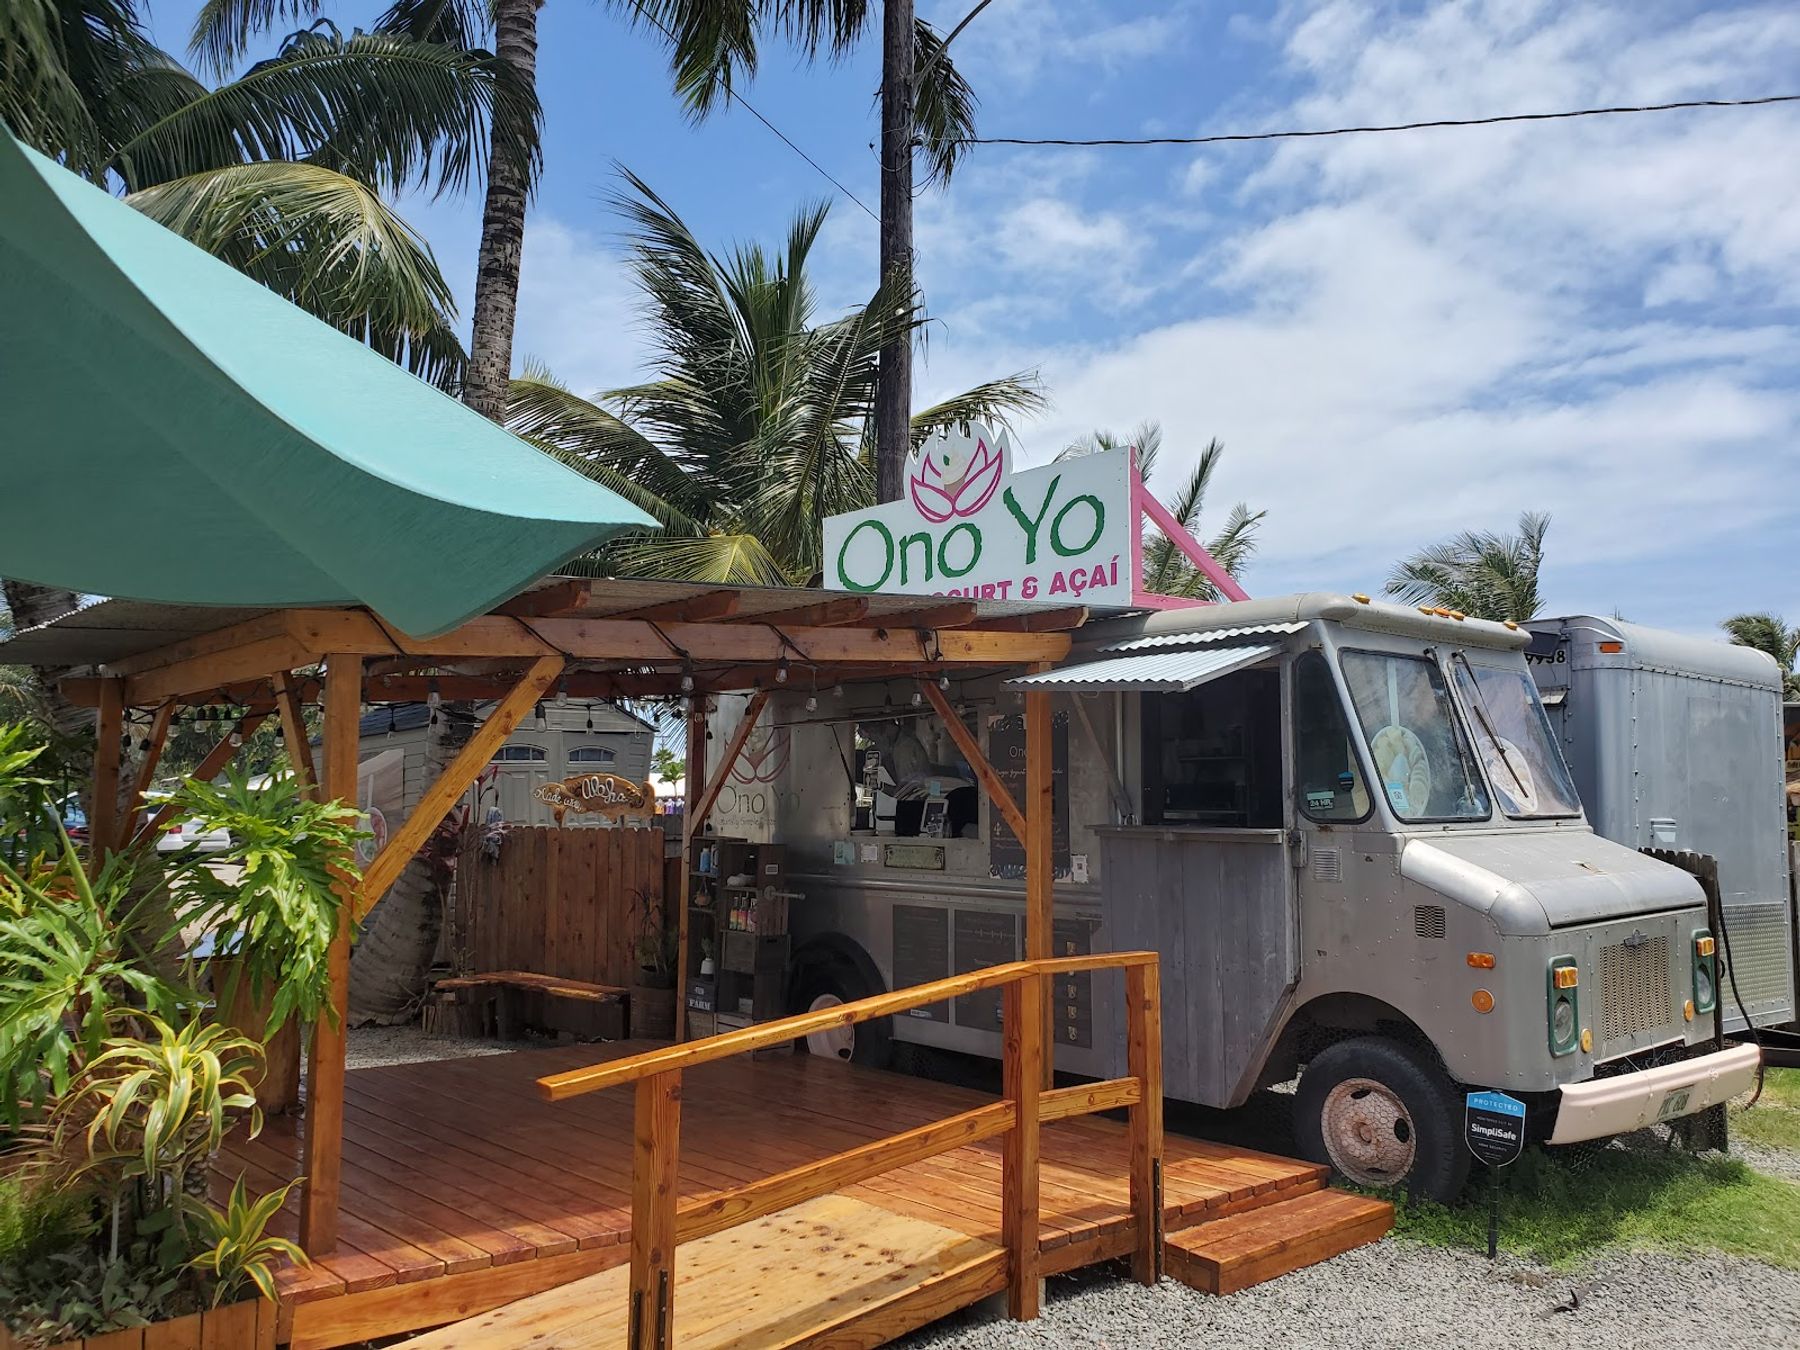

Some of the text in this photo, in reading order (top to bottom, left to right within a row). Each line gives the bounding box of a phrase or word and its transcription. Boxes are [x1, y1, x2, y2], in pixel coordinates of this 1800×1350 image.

[837, 474, 1105, 592] Ono Yo
[1021, 576, 1039, 600] &
[1048, 554, 1120, 598] AÇAÍ
[581, 775, 629, 805] Aloha
[717, 785, 765, 814] Ono
[1473, 1097, 1518, 1112] PROTECTED
[1471, 1122, 1516, 1141] SimpliSafe
